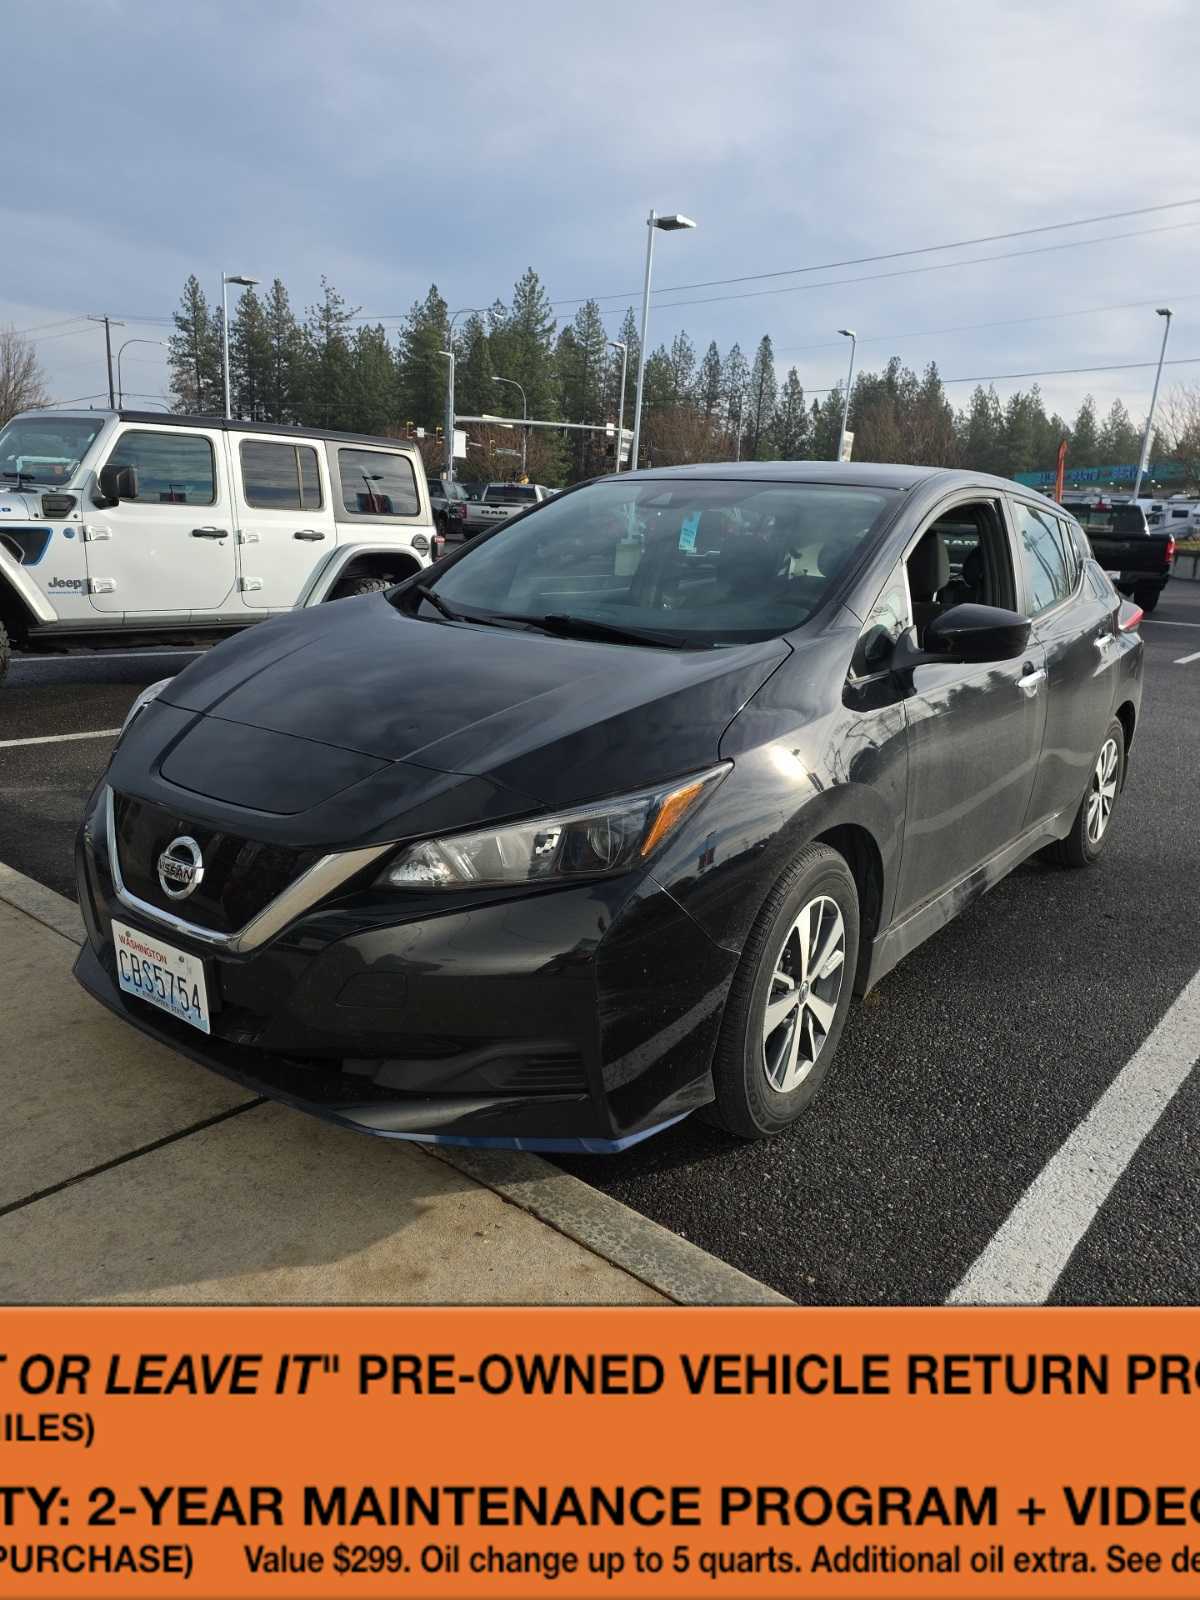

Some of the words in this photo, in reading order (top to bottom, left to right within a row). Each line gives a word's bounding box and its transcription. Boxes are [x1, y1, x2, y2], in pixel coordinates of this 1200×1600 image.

[48, 576, 82, 590] Jeep
[160, 859, 194, 881] NISSAN
[118, 934, 168, 965] WASHINGTON
[119, 949, 202, 1019] CBS5754
